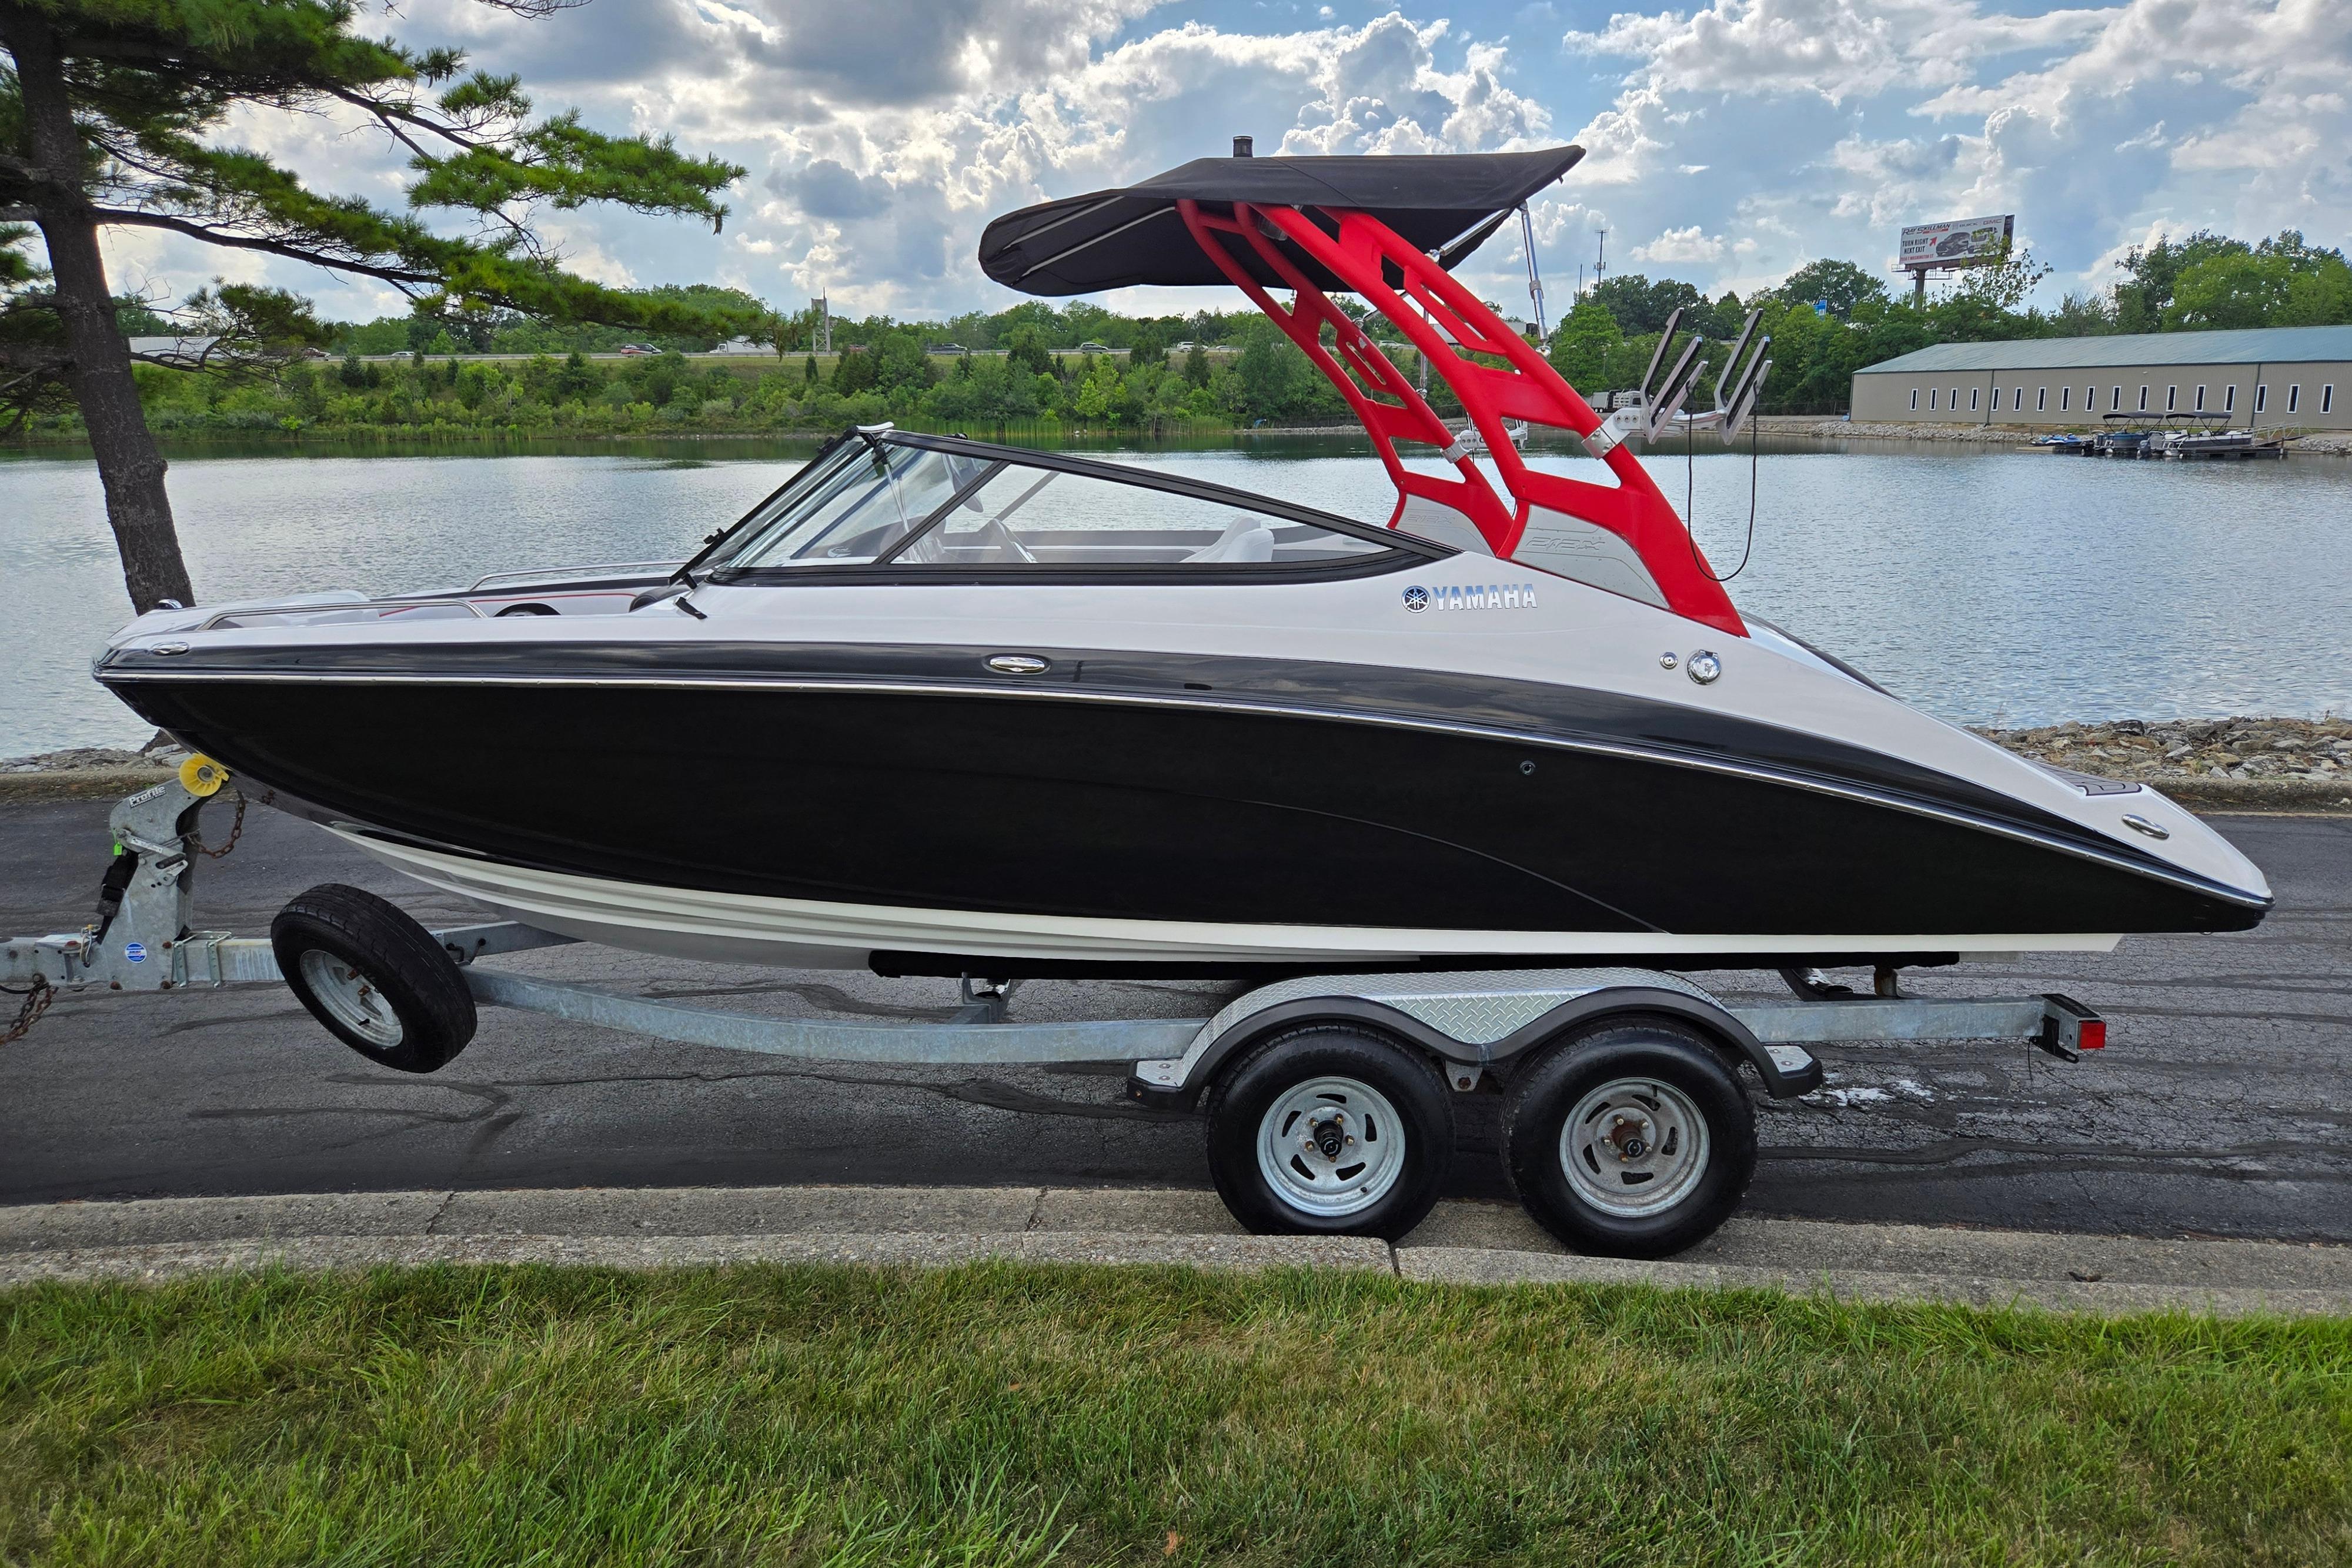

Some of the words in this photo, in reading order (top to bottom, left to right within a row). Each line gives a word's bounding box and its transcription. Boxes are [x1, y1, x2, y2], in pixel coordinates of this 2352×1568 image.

[1902, 227, 1917, 236] RAY
[1917, 224, 1950, 233] SKILLMAN
[1915, 238, 1929, 246] RIGHT
[1525, 536, 1606, 551] 212X
[1432, 583, 1538, 611] YAMAHA
[129, 786, 165, 805] Profile
